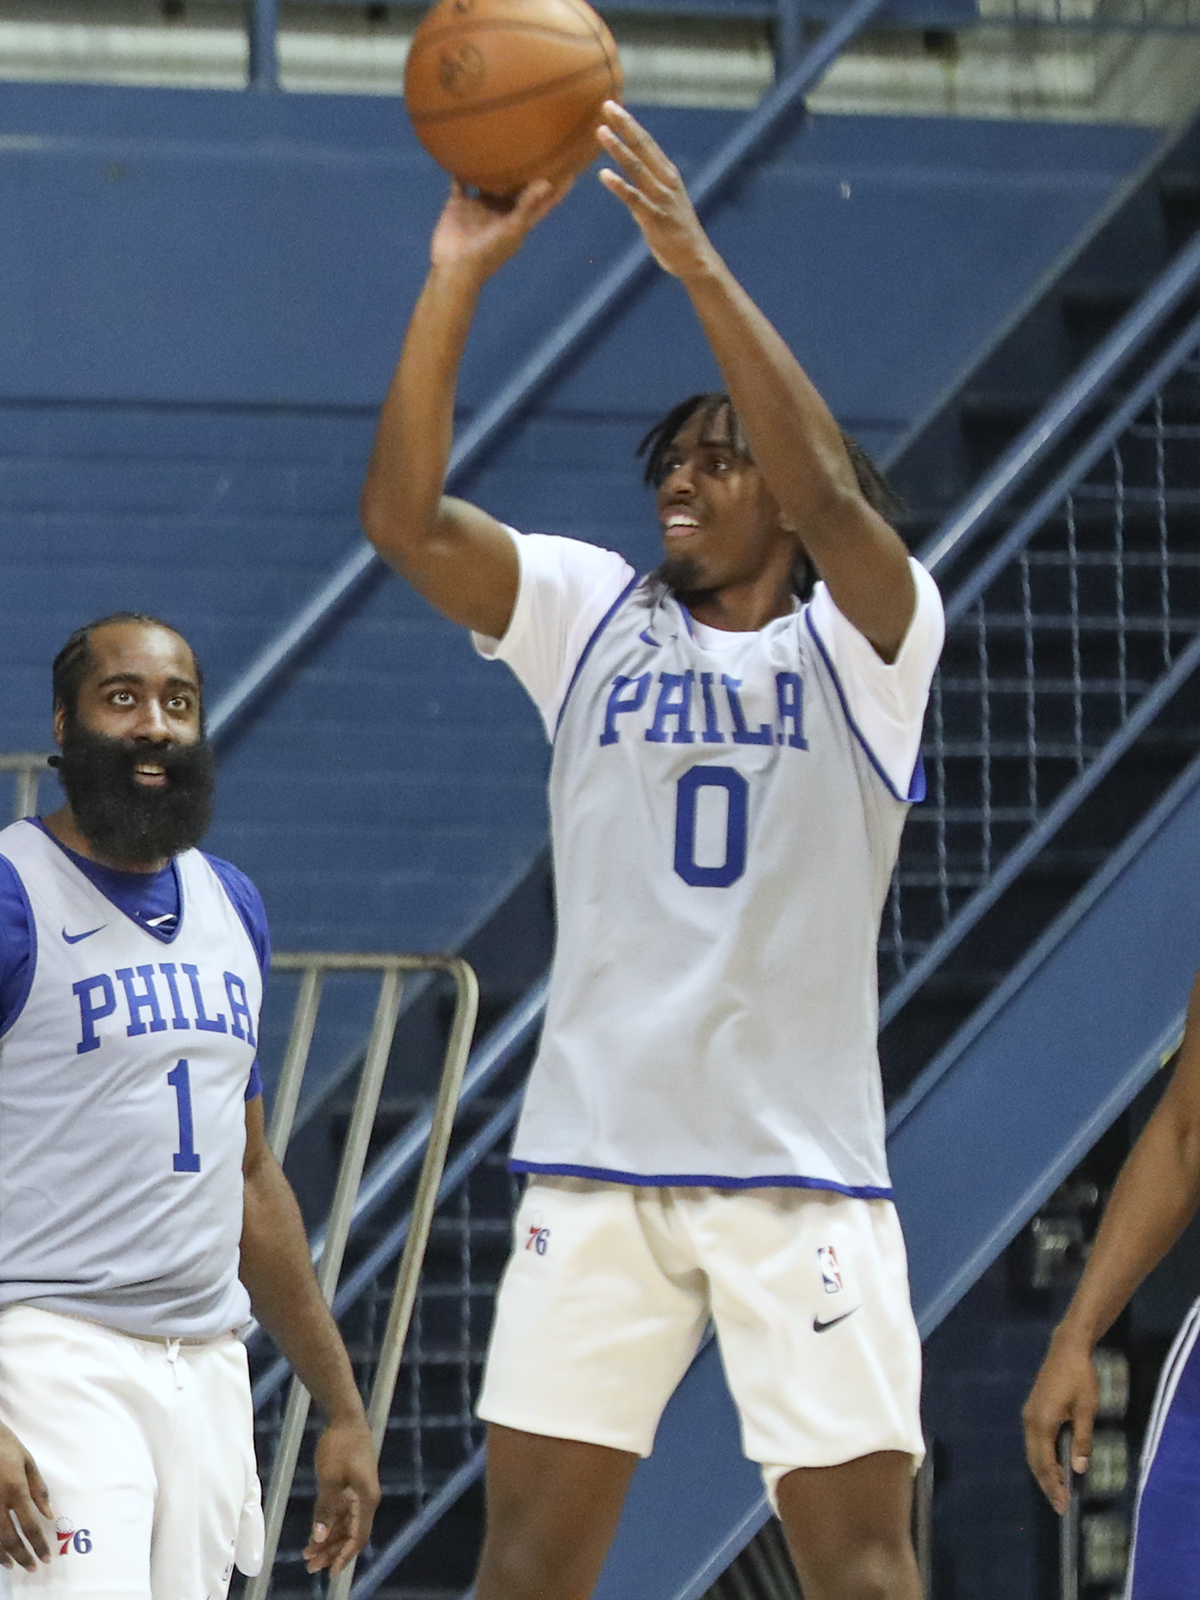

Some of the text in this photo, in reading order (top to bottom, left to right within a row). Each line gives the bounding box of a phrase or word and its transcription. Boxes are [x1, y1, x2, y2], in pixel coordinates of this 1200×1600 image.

[674, 765, 749, 888] 0
[72, 963, 257, 1054] PHILA
[167, 1059, 201, 1172] 1
[525, 1226, 551, 1256] 76
[56, 1528, 92, 1556] 76
